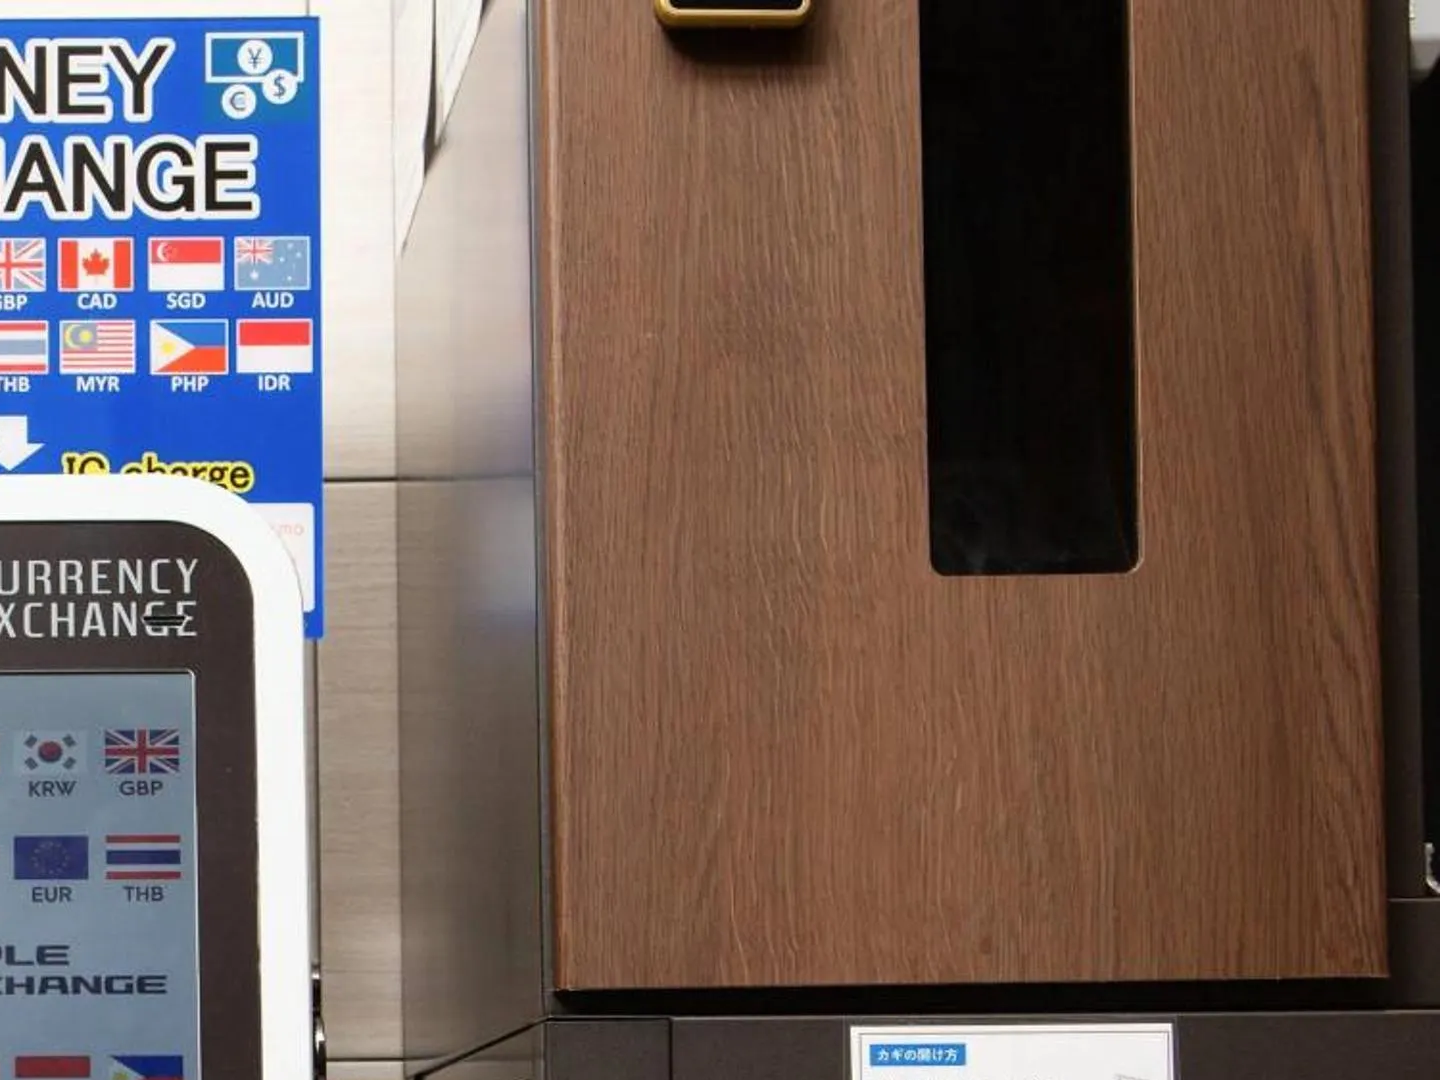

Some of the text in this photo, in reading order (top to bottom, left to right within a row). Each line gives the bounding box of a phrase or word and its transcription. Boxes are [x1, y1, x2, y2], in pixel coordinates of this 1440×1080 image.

[77, 293, 118, 311] CAD
[166, 293, 207, 310] SGD
[252, 292, 295, 309] AUD
[76, 376, 120, 393] MYR
[171, 376, 210, 393] PHP
[258, 375, 291, 392] IDR
[28, 781, 77, 798] KRW
[119, 780, 163, 797] GBP
[32, 886, 72, 903] EUR
[123, 886, 164, 902] THB
[877, 1047, 957, 1063] カギの開け方
